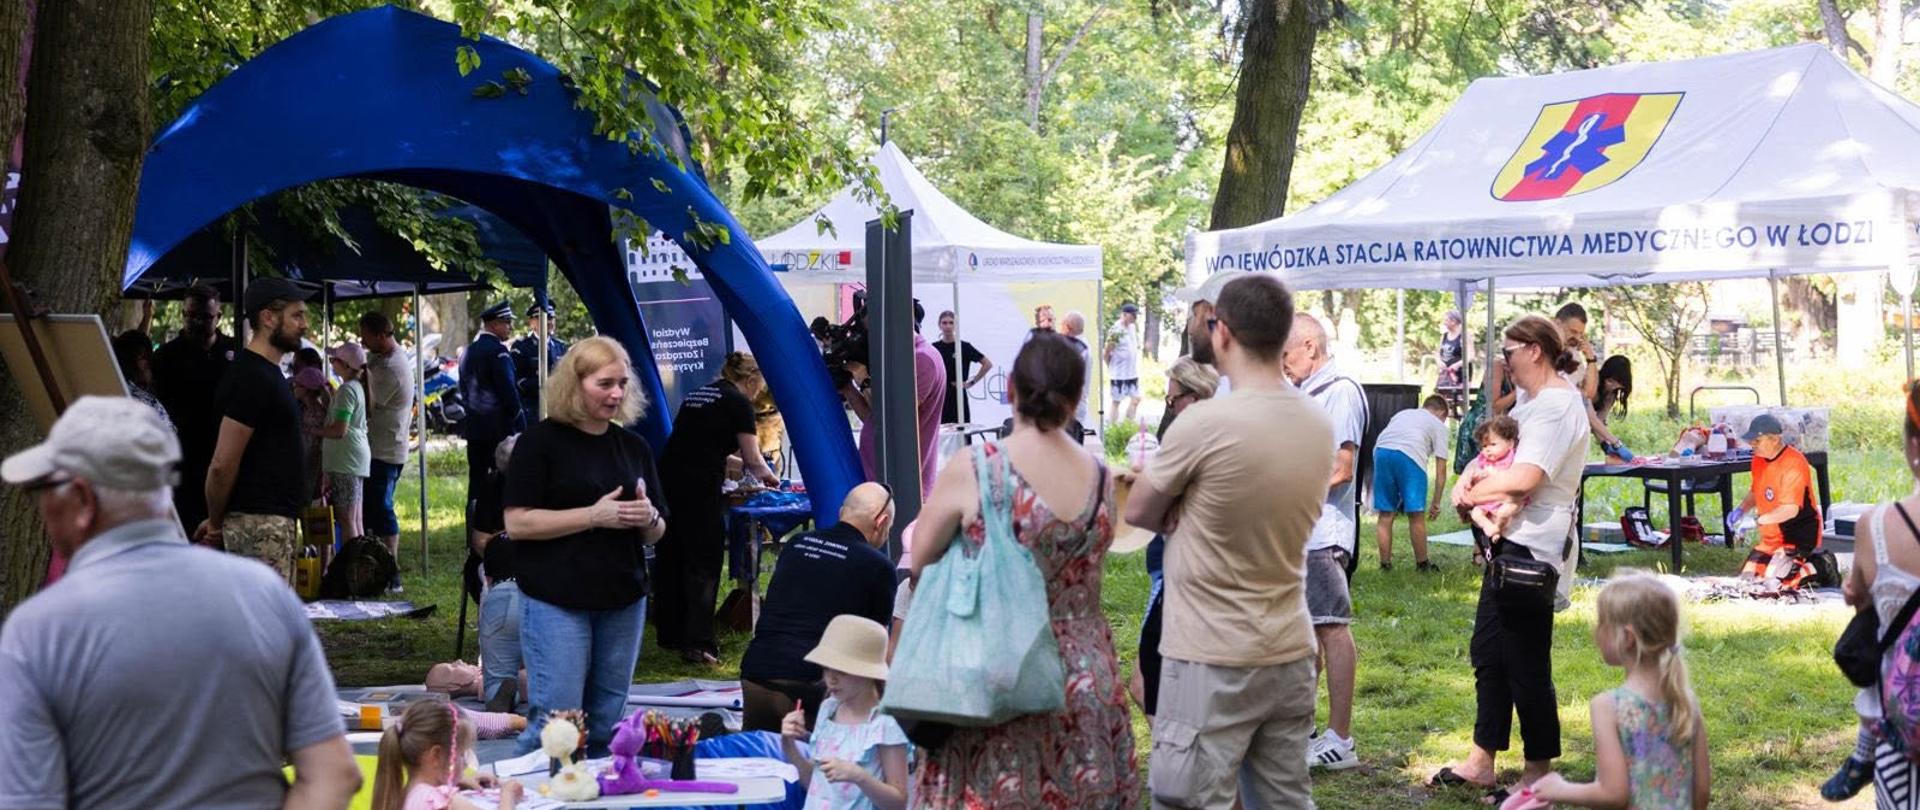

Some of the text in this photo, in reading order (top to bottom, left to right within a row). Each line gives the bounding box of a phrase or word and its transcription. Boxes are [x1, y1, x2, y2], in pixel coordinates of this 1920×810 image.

[1206, 220, 1874, 274] WOJEWÓDZKA STACJA RATOWNICTWA MEDYCZNEGO W ŁODZI
